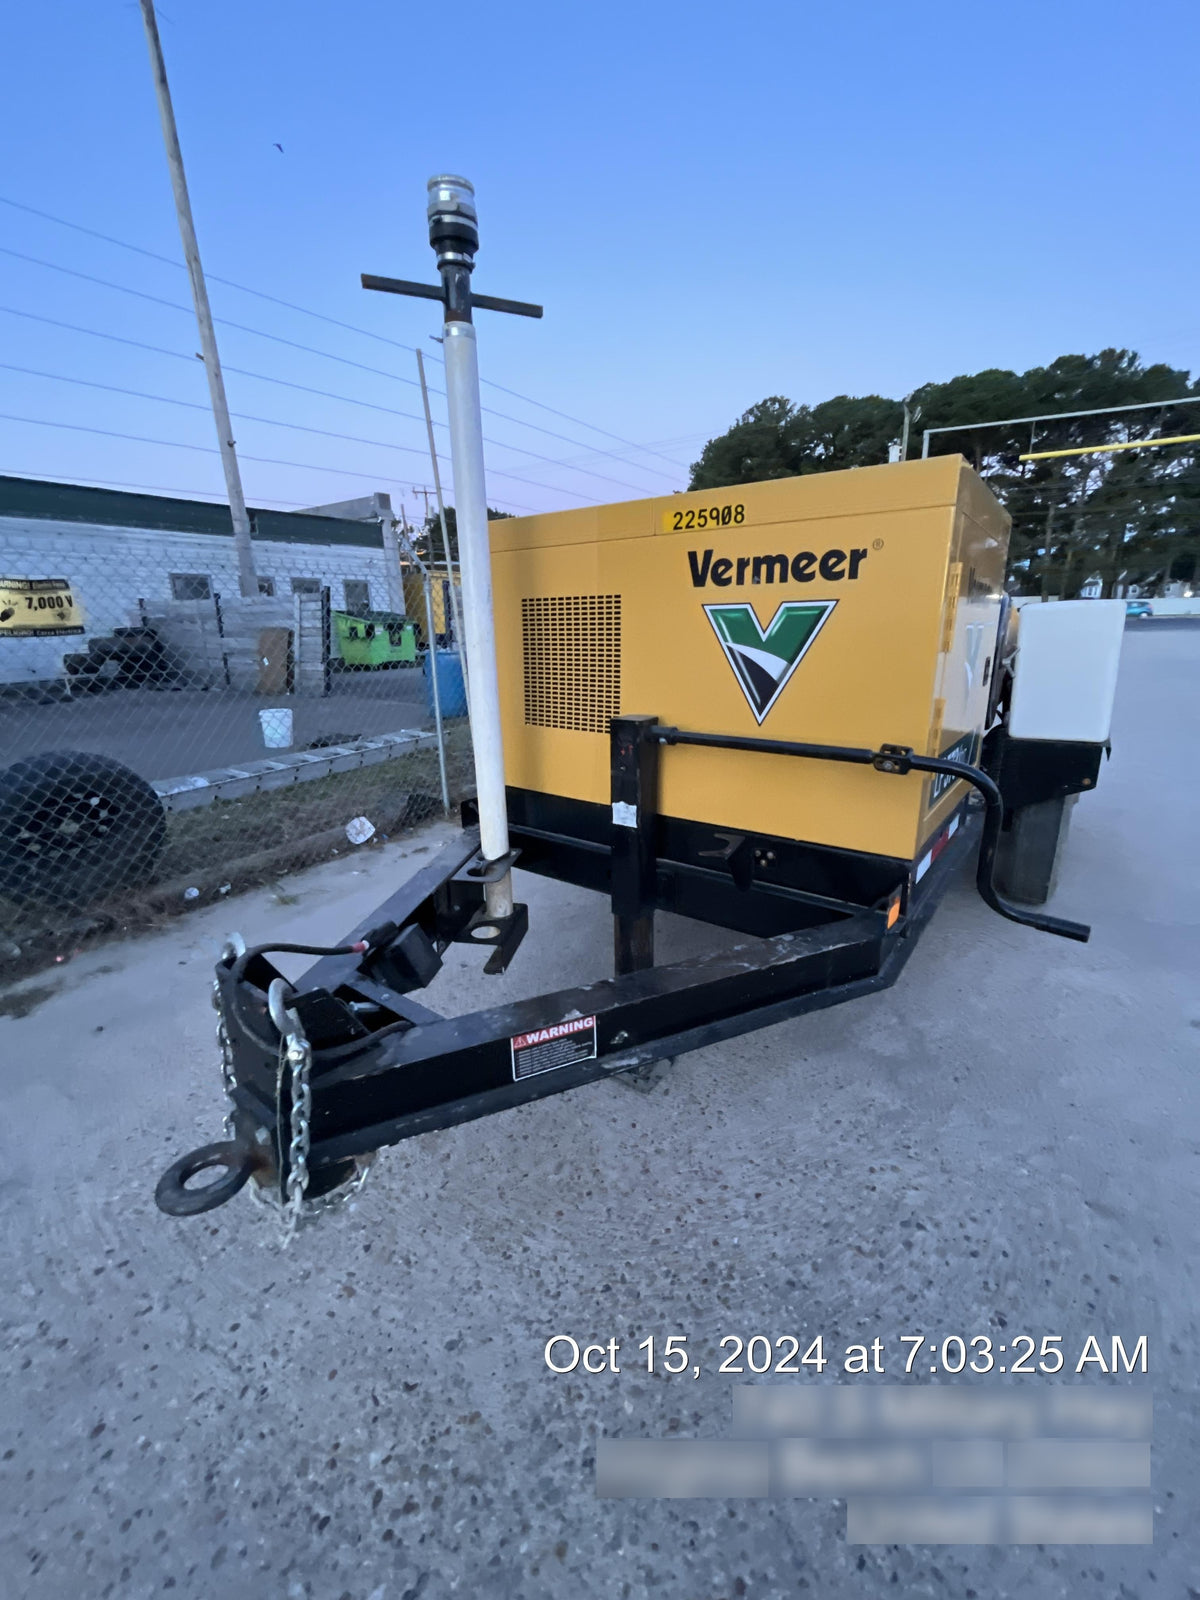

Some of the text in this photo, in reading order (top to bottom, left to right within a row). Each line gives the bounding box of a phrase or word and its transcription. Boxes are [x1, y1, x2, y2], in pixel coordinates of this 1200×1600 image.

[673, 503, 746, 531] 225908
[687, 548, 868, 588] Vermeer
[25, 594, 73, 611] 7,000 V
[526, 1017, 594, 1044] WARNING
